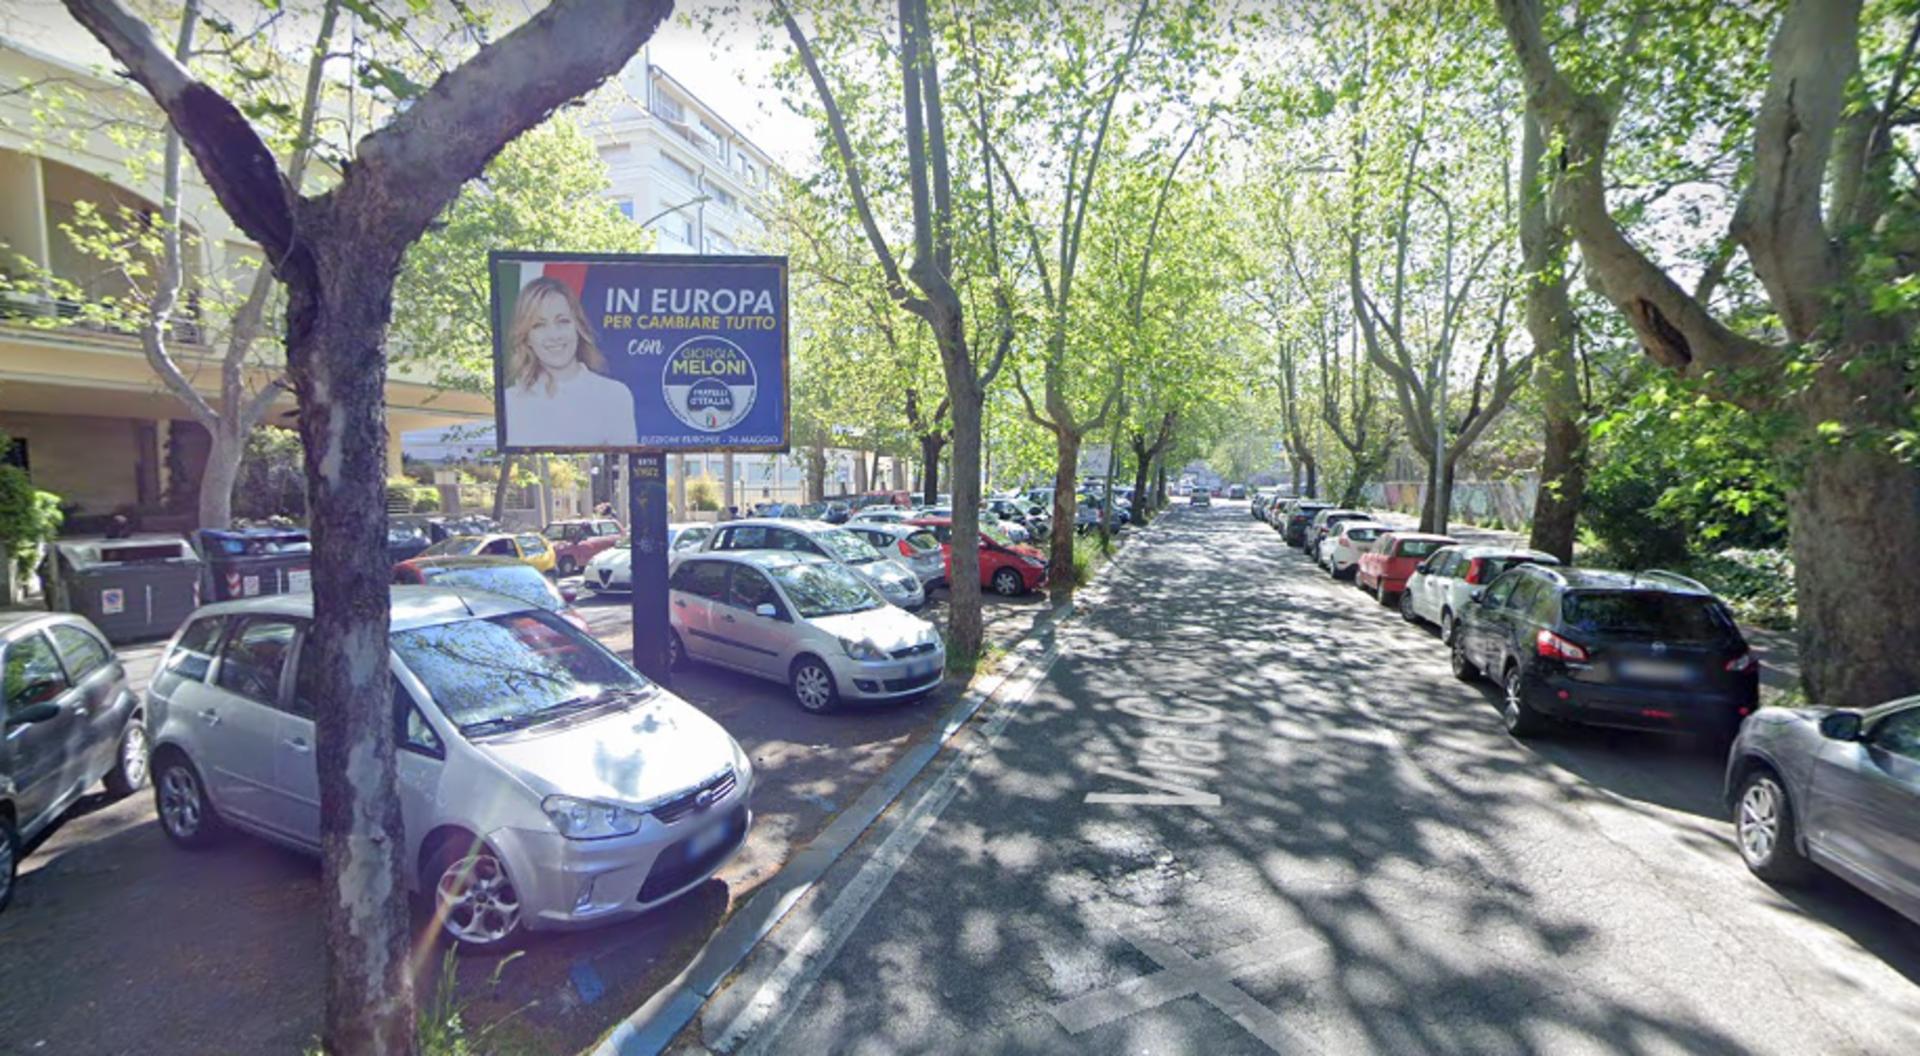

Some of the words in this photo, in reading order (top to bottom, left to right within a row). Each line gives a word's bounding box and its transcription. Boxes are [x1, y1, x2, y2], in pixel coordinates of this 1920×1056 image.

[605, 288, 640, 313] IN
[652, 288, 775, 315] EUROPA
[603, 315, 632, 329] PER
[637, 315, 720, 330] CAMBIARE
[726, 316, 777, 330] TUTTO
[628, 338, 664, 356] con
[681, 347, 737, 360] GIORGIA
[672, 359, 747, 376] MELONI
